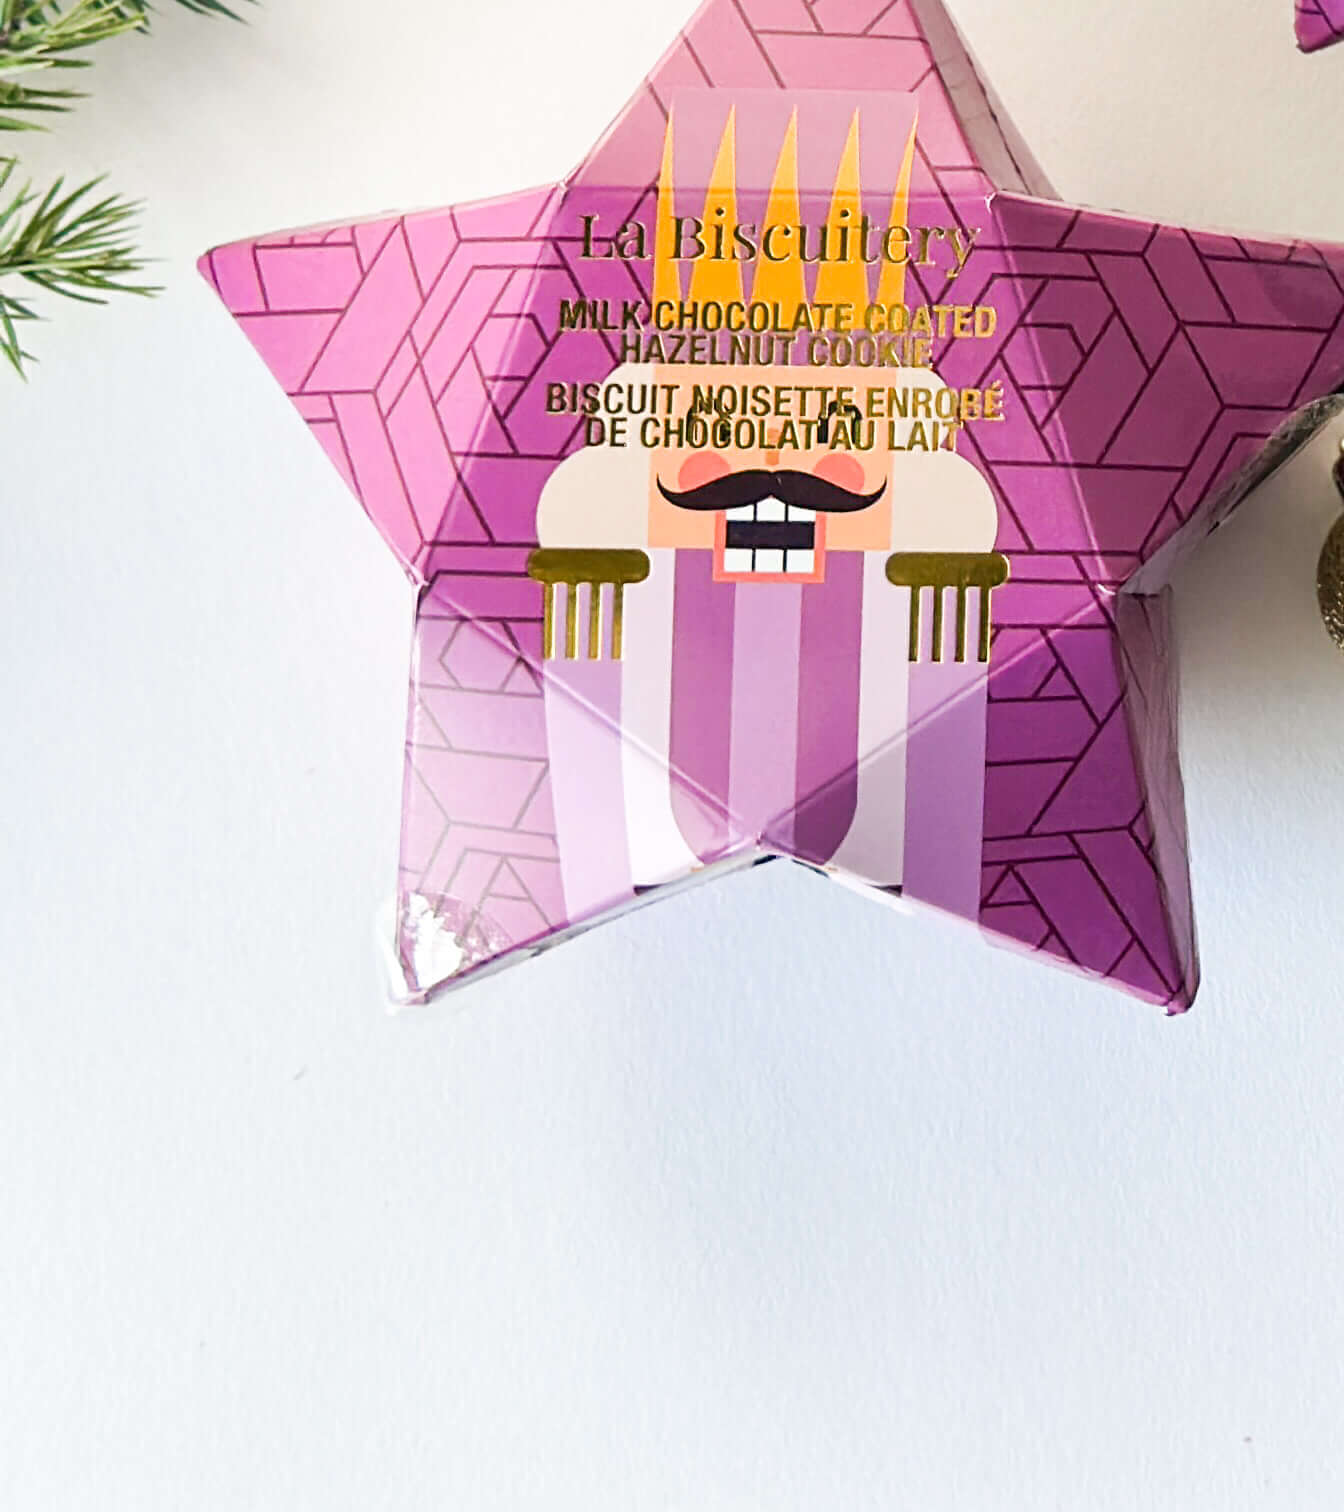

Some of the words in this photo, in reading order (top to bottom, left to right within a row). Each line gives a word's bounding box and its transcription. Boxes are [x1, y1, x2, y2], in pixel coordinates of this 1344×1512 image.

[579, 213, 652, 261] La
[672, 208, 981, 279] Biscuitery
[559, 298, 647, 332] MILK
[653, 299, 854, 333] CHOCOLATE
[863, 302, 998, 339] COATED
[620, 332, 798, 366] HAZELNUT
[809, 334, 933, 369] COOKIE
[545, 382, 680, 415] BISCUIT
[692, 384, 857, 417] NOISETTE
[868, 381, 1004, 421] ENROBÉ
[586, 416, 630, 448] DE
[640, 418, 821, 450] CHOCOLAT
[830, 419, 875, 451] AU
[887, 421, 964, 452] LAIT
